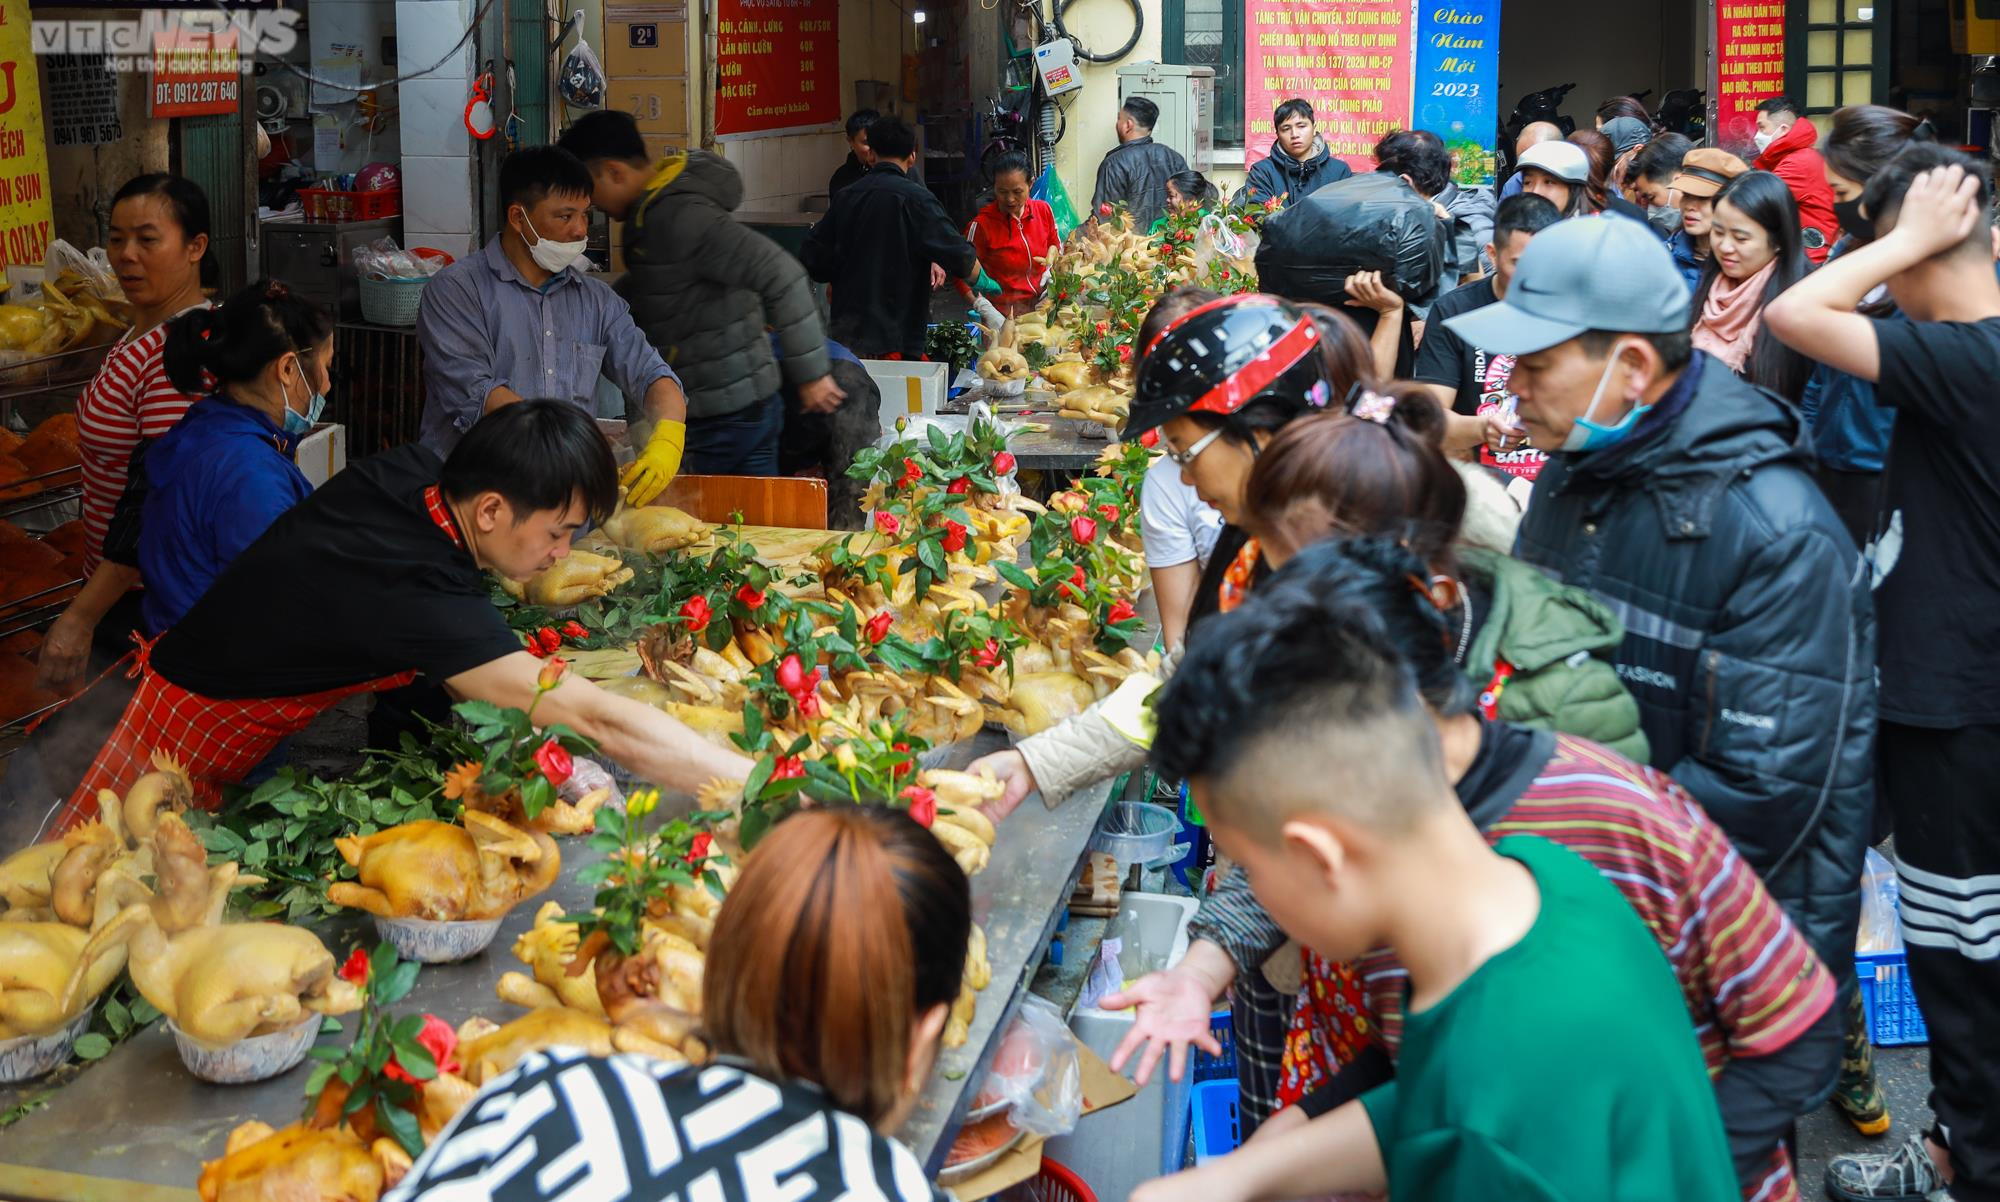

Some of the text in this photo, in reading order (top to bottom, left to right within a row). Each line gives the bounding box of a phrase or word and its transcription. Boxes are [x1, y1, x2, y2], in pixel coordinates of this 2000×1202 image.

[1255, 9, 1275, 25] TÀNG
[1295, 9, 1310, 28] VẬN
[1346, 7, 1357, 25] SỬ
[1358, 11, 1379, 28] DỤNG
[1381, 9, 1402, 28] HOẶC
[1433, 8, 1484, 25] Chào
[1733, 4, 1752, 18] NHÂN
[1754, 3, 1768, 18] DÂN
[1732, 25, 1741, 37] RA
[1743, 22, 1756, 37] SỨC
[1758, 24, 1769, 37] THI
[1260, 29, 1284, 47] CHIẾM
[1285, 32, 1304, 49] ĐOẠT
[1306, 31, 1326, 47] PHÁO
[1342, 34, 1360, 47] THEO
[1362, 34, 1377, 48] QUY
[1379, 34, 1397, 50] ĐỊNH
[1431, 32, 1485, 49] Năm
[1740, 43, 1761, 58] MẠNH
[1762, 43, 1776, 58] HỌC
[1263, 55, 1275, 71] TẠI
[1277, 55, 1294, 71] NGHỊ
[1296, 55, 1314, 72] ĐỊNH
[1316, 51, 1327, 69] SỐ
[1434, 57, 1477, 76] Mới
[1730, 60, 1745, 75] LÀM
[1746, 62, 1762, 75] THEO
[1264, 74, 1284, 91] NGÀY
[1333, 72, 1348, 91] CỦA
[1350, 75, 1374, 91] CHÍNH
[1376, 72, 1392, 91] PHỦ
[1431, 82, 1480, 98] 2023
[1722, 81, 1735, 97] ĐẠO
[1753, 80, 1775, 93] PHONG
[174, 82, 199, 104] 0912
[200, 81, 218, 102] 287
[220, 81, 237, 101] 640
[1328, 94, 1338, 112] SỬ
[1340, 99, 1360, 115] DỤNG
[1362, 96, 1383, 113] PHÁO
[1357, 119, 1370, 136] VẬT
[15, 173, 42, 208] SỤN
